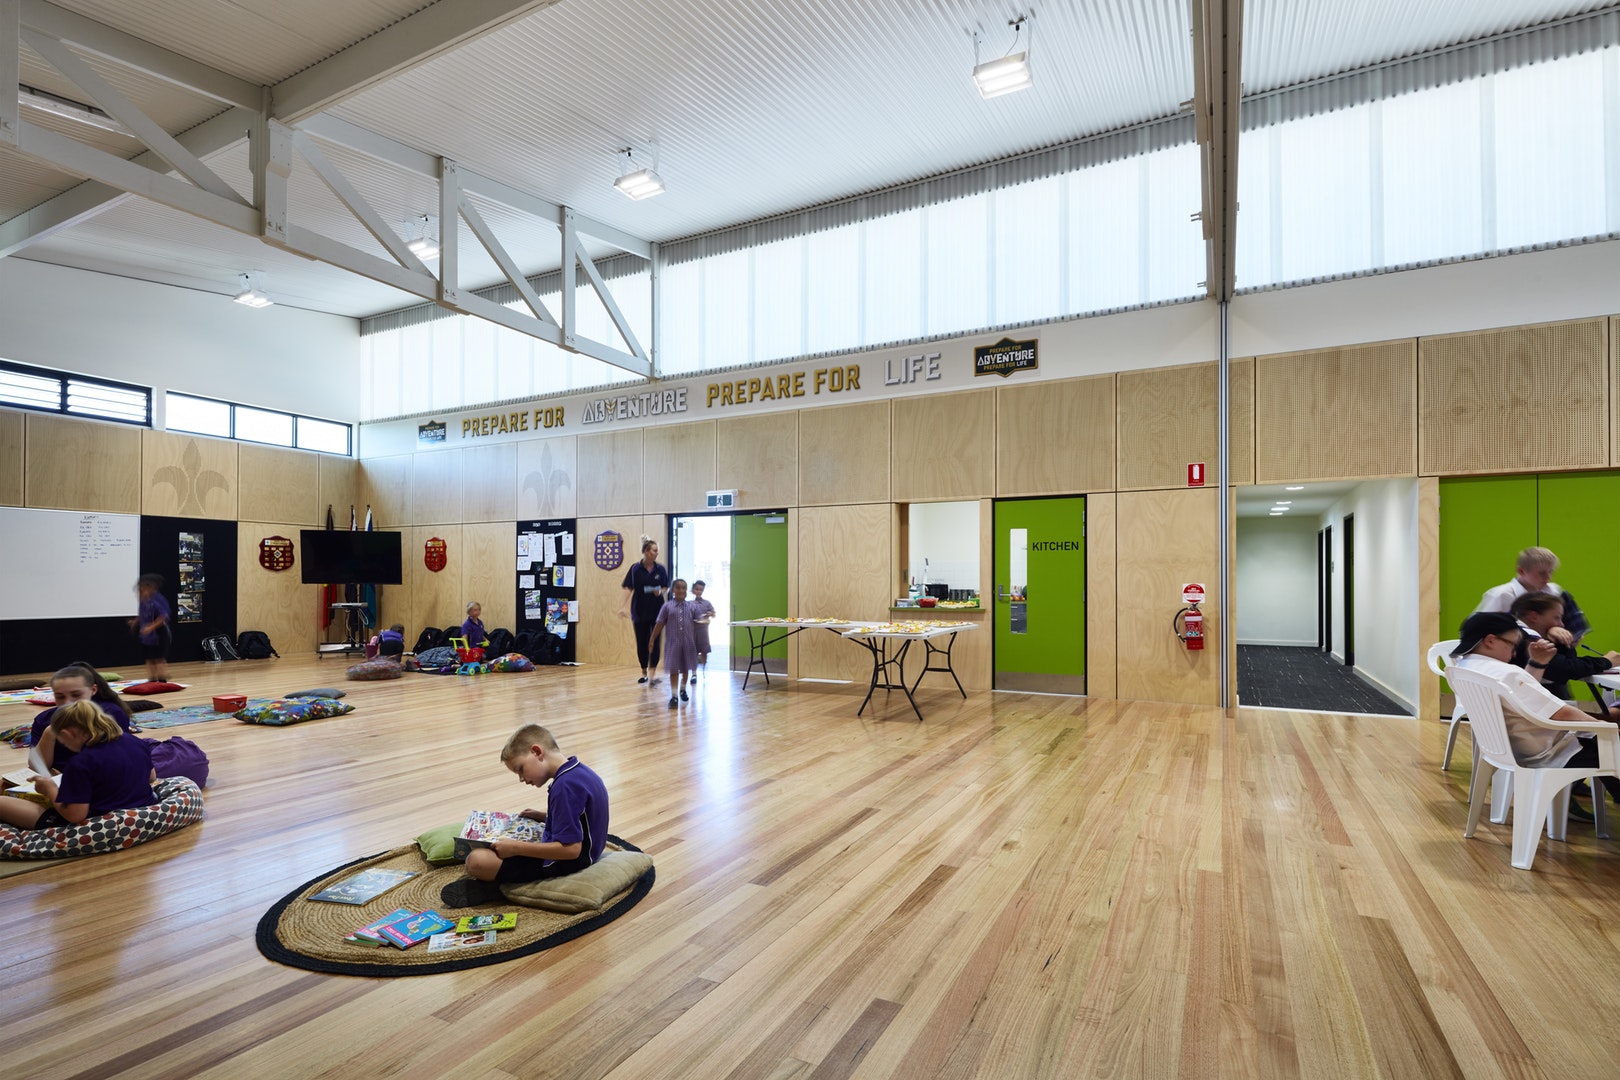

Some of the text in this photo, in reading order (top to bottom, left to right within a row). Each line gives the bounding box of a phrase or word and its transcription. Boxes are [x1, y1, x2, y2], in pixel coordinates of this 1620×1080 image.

[977, 349, 1034, 366] ADVENTURE
[461, 352, 941, 439] PREPARE FOR ADVENTURE PREPARE FOR LIFE
[1032, 541, 1079, 551] KITCHEN
